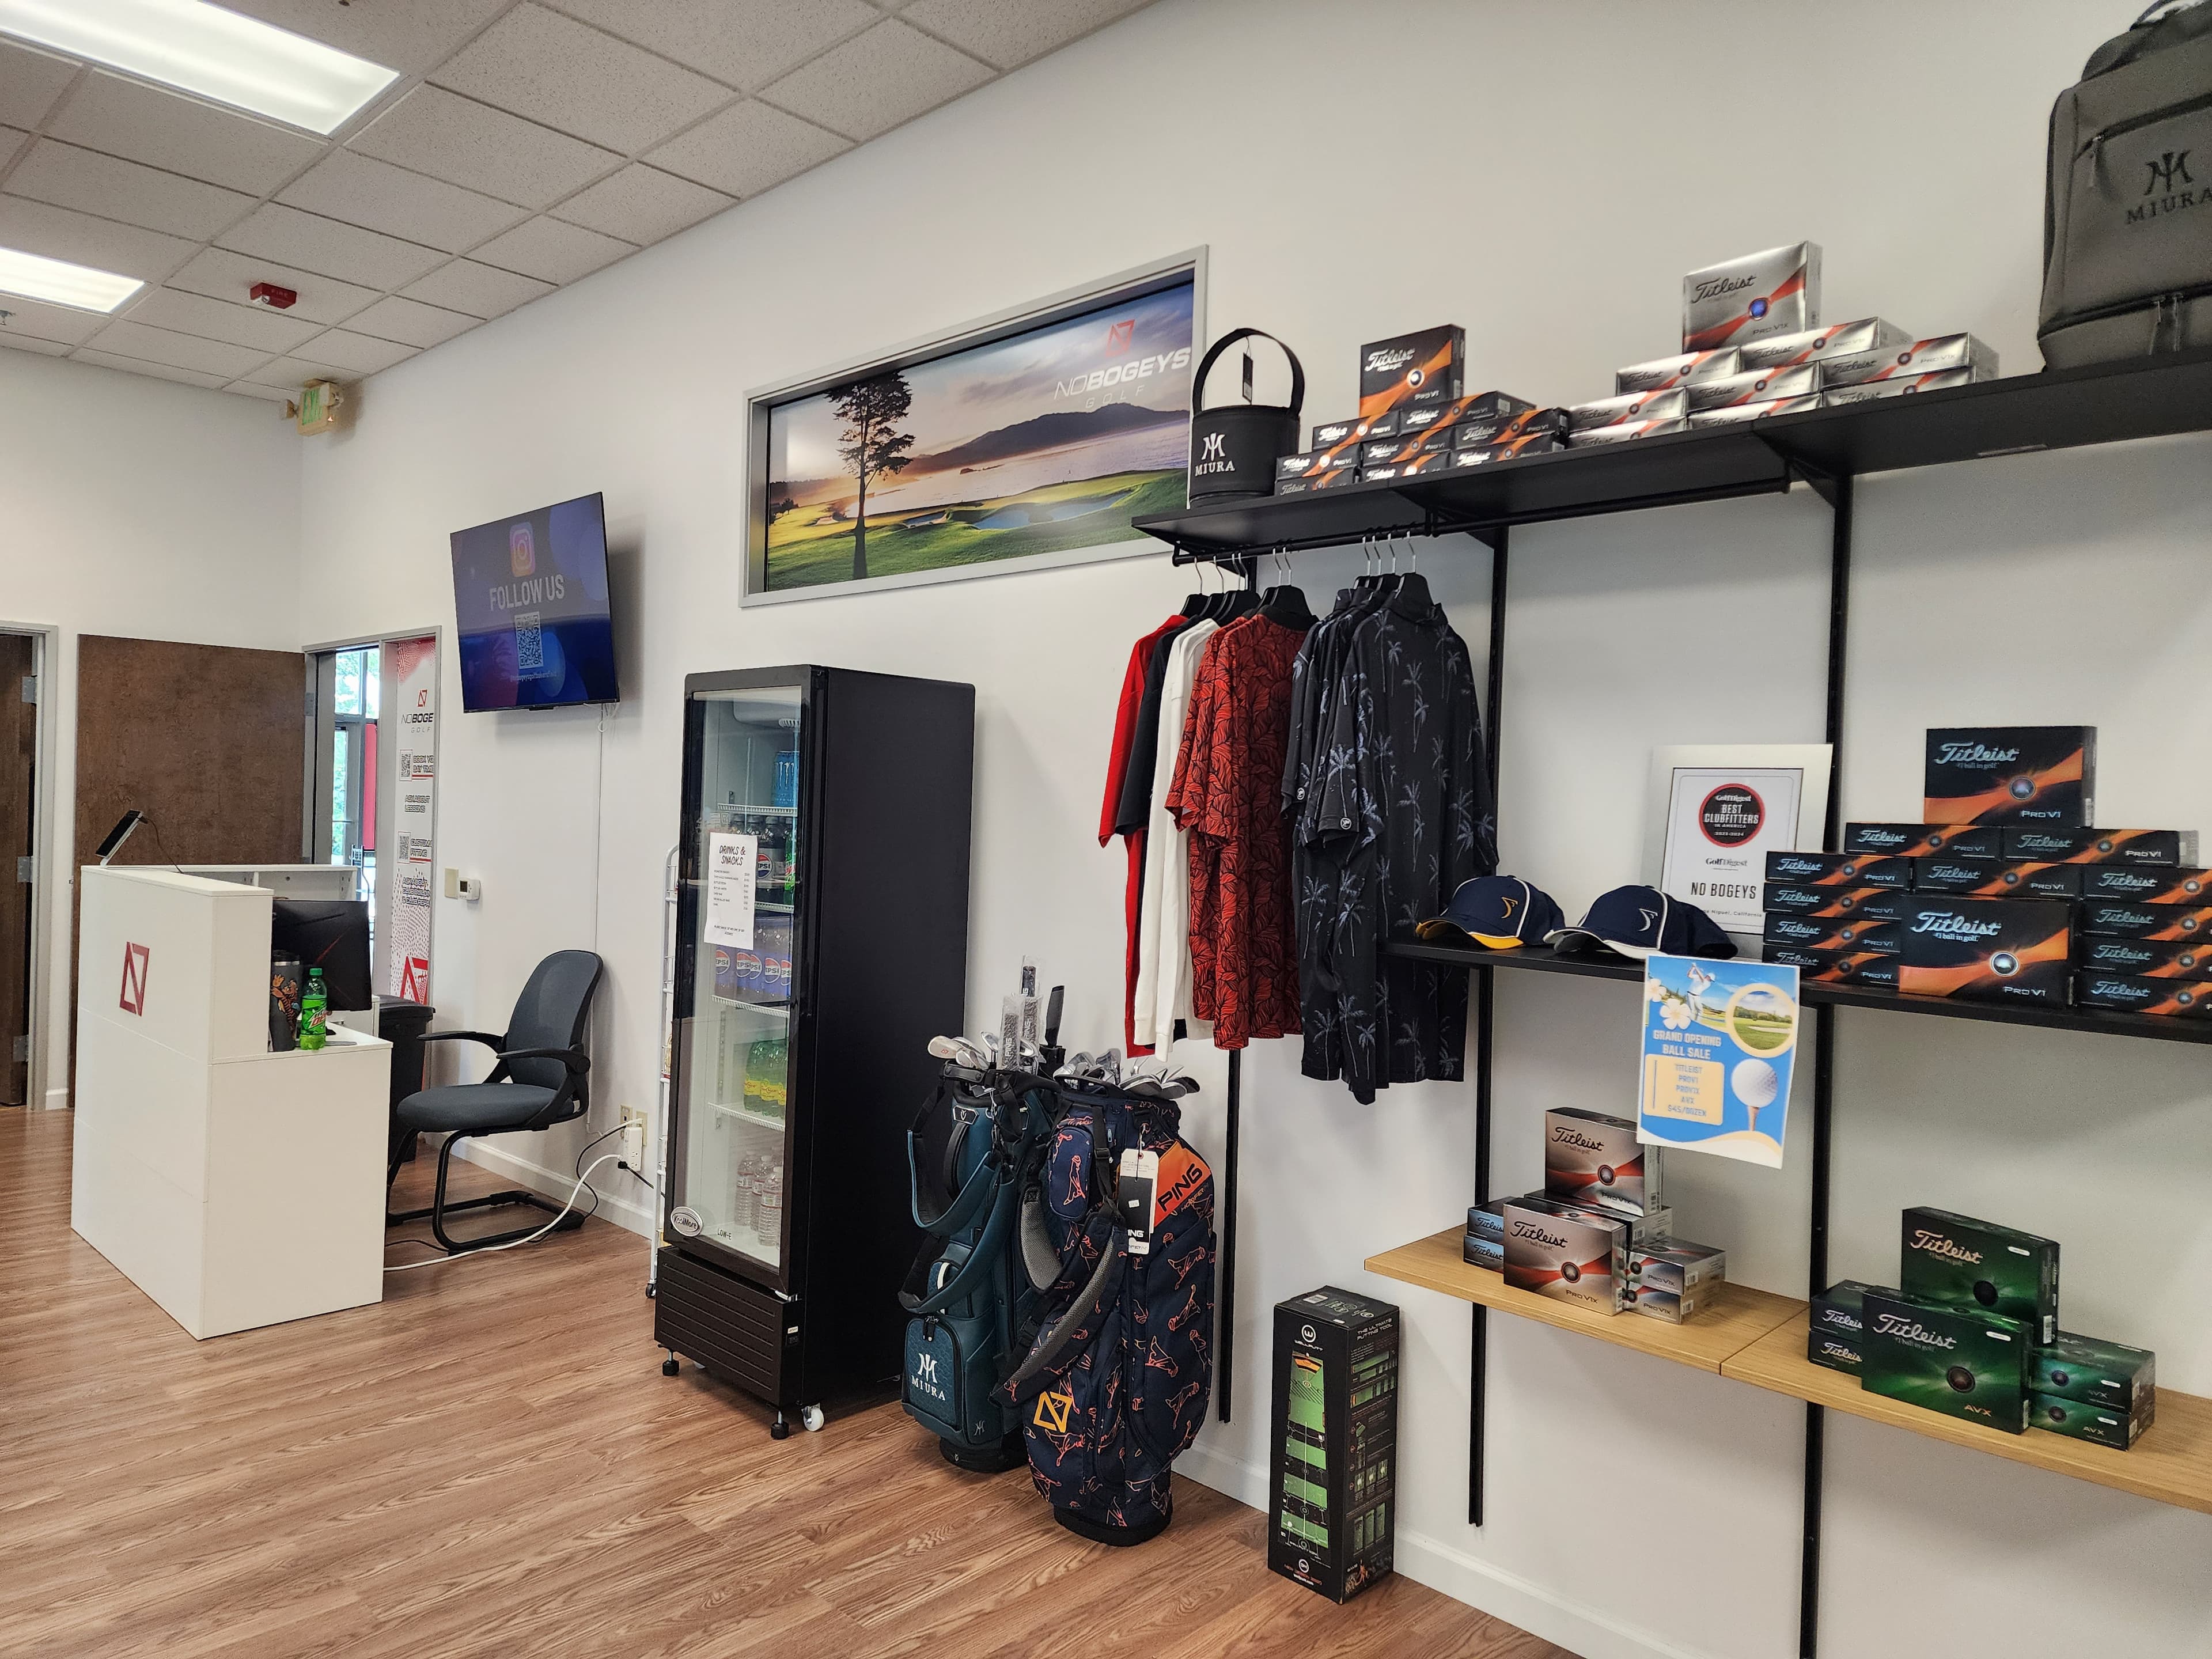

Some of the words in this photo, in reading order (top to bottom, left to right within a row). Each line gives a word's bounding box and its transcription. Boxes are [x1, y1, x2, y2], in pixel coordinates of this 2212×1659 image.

[1691, 275, 1757, 304] Titleist
[1756, 346, 1794, 358] Titleist
[1365, 348, 1415, 372] Titleist
[1834, 360, 1877, 373] Titleist
[1628, 372, 1664, 382] Titleist
[1085, 385, 1145, 408] GOLF
[1699, 387, 1737, 399] Titleist
[1406, 410, 1440, 424] Titleist
[1578, 409, 1613, 422] Titleist
[1462, 426, 1497, 441] Titleist
[1368, 443, 1399, 458] Titleist
[1195, 461, 1236, 476] MIURA
[1280, 483, 1307, 495] Titleist
[490, 578, 542, 611] FOLLOW
[545, 574, 566, 601] US
[412, 755, 426, 763] BOOK
[1935, 741, 2020, 764] Titleist
[1721, 804, 1743, 813] BEST
[2021, 810, 2046, 818] PRO
[1703, 813, 1759, 824] CLUBFITTERS
[1857, 830, 1907, 843] Titleist
[2017, 835, 2073, 849] Titleist
[410, 849, 427, 857] FITTING
[719, 845, 740, 855] DRINKS
[741, 846, 746, 855] &
[721, 855, 744, 866] SNACKS
[1776, 858, 1824, 871] Titleist
[1928, 866, 1981, 879] Titleist
[2098, 873, 2158, 887] Titleist
[1691, 882, 1706, 896] NO
[1710, 883, 1757, 900] BOGEYS
[1774, 890, 1821, 903] Titleist
[1910, 911, 2002, 935] Titleist
[2095, 908, 2155, 924] Titleist
[1775, 921, 1821, 934] Titleist
[1775, 952, 1819, 966] Titleist
[2093, 945, 2153, 960] Titleist
[2003, 986, 2029, 995] PRO
[2091, 981, 2151, 997] Titleist
[1653, 1029, 1683, 1043] GRAND
[1684, 1033, 1722, 1047] OPENING
[1662, 1044, 1685, 1057] BALL
[1687, 1047, 1711, 1060] SALE
[1551, 1127, 1604, 1152] Titleist
[1157, 1163, 1203, 1211] PING
[674, 1215, 697, 1229] KoolMore
[1475, 1217, 1503, 1232] Titleis
[717, 1228, 732, 1240] LOW-E
[1510, 1221, 1568, 1248] Titleist
[1471, 1244, 1503, 1260] Titleist
[1910, 1229, 1983, 1264] Titleist
[1566, 1289, 1582, 1300] PRO
[1872, 1313, 1957, 1350] Titleist
[911, 1374, 946, 1401] MIURA
[1964, 1404, 1992, 1417] AVX
[2082, 1426, 2105, 1436] AVX
